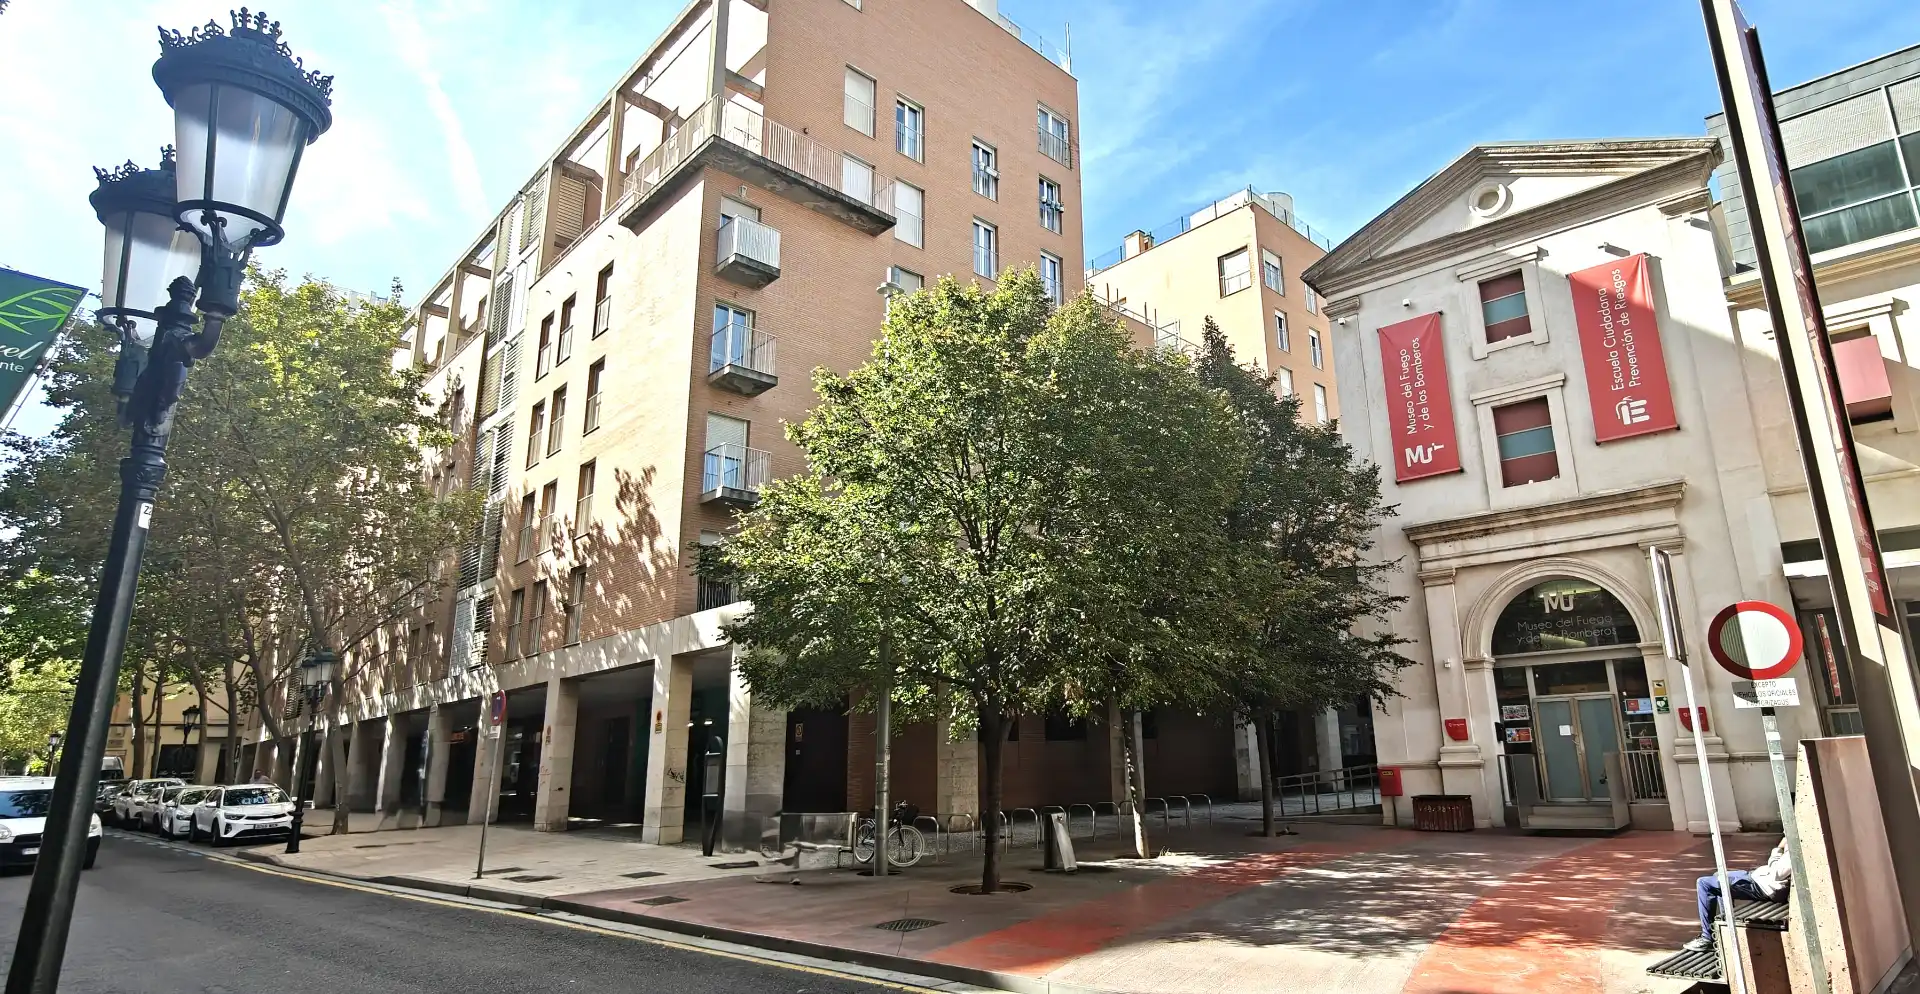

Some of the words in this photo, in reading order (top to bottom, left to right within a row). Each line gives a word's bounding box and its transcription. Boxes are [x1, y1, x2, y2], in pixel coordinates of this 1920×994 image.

[1611, 268, 1627, 310] Riesgos
[1597, 287, 1617, 348] Ciudadana
[1616, 312, 1630, 326] de
[1399, 348, 1411, 381] Fuego
[1411, 337, 1426, 388] Bomberos
[1605, 350, 1625, 391] Escuela
[1622, 328, 1642, 388] Prevención
[1400, 381, 1412, 398] del
[1416, 389, 1428, 405] los
[1406, 400, 1417, 435] Museo
[1418, 406, 1430, 421] de
[1423, 423, 1435, 431] y
[1517, 621, 1553, 631] Museo
[1555, 616, 1573, 628] del
[1577, 615, 1612, 626] Fuego
[1526, 630, 1540, 644] de
[1561, 626, 1617, 639] Bomberos
